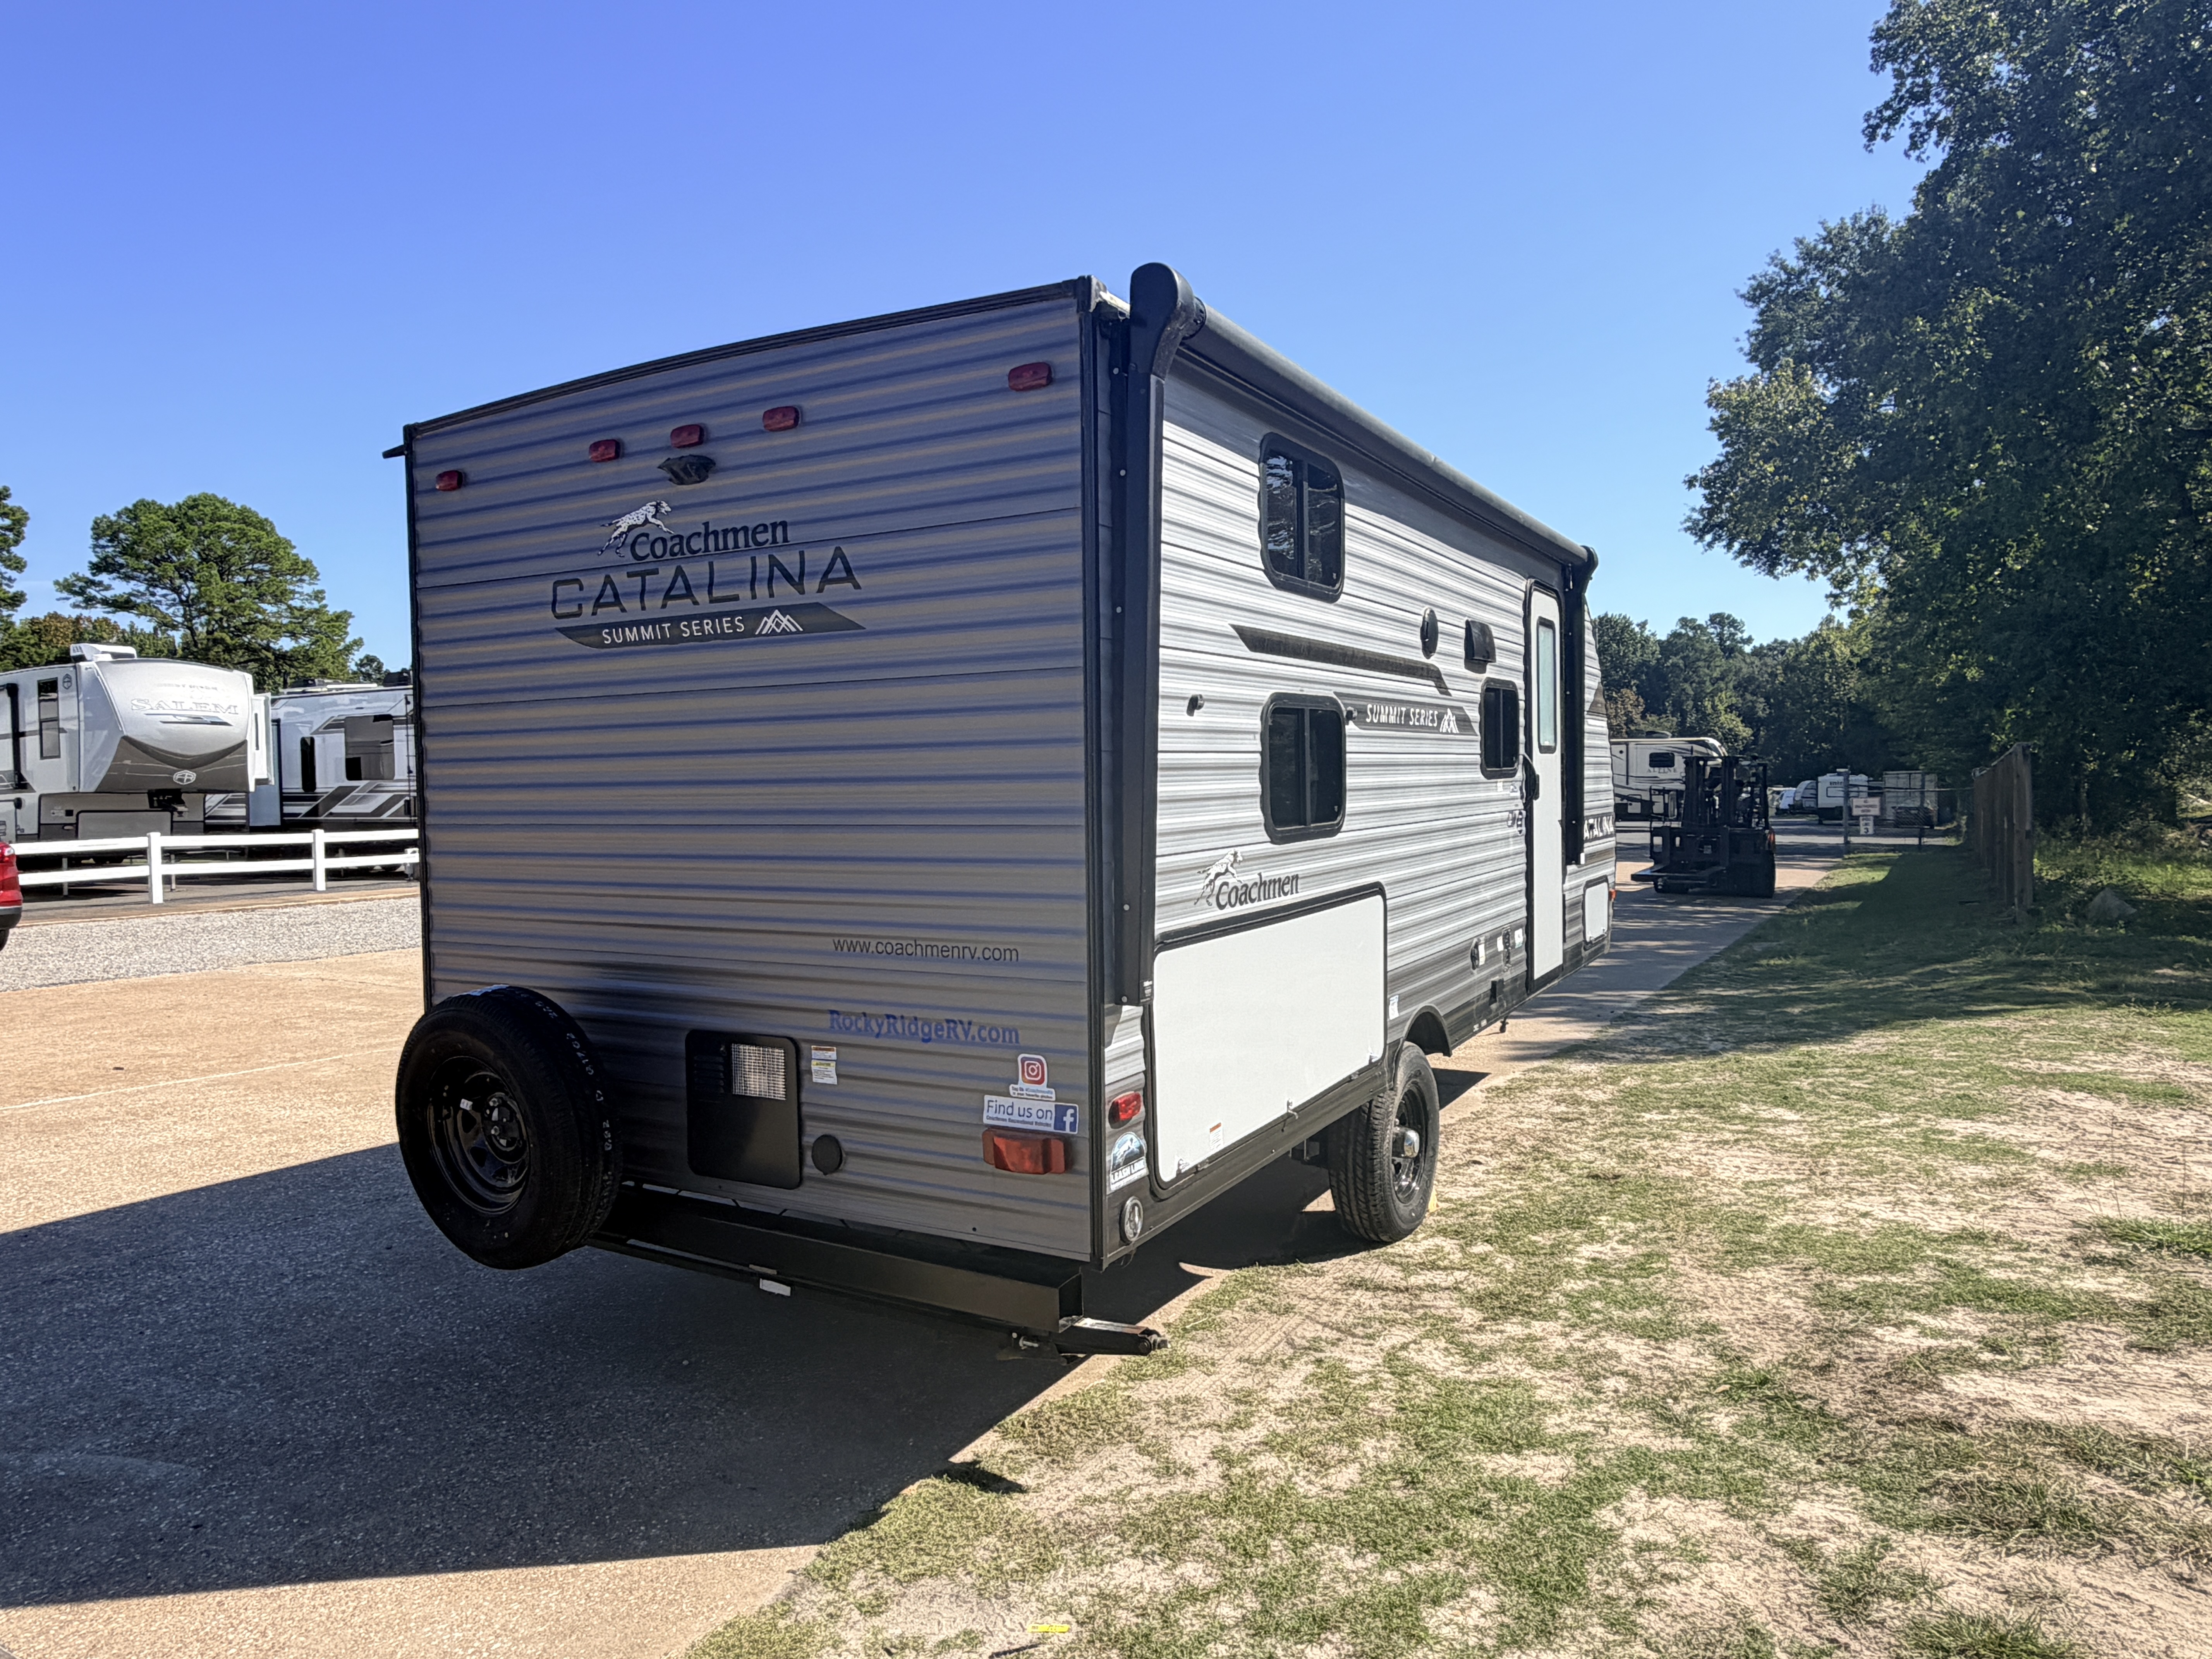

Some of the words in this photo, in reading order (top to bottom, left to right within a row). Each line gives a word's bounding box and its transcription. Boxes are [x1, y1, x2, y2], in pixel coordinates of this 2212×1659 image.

[630, 520, 790, 561] Coachmen
[551, 546, 862, 620] CATALINA
[602, 623, 671, 644] SUMMIT
[680, 616, 745, 637] SERIES
[131, 698, 239, 714] SALEM
[1365, 703, 1407, 724] SUMMIT
[1409, 708, 1438, 727] SERIES
[1216, 872, 1299, 910] Coachmen
[832, 938, 1019, 962] www.coachmenrv.com
[828, 1009, 1020, 1043] RockyRidgeRV.com
[987, 1099, 1014, 1116] Find
[1018, 1106, 1032, 1118] us
[1036, 1108, 1053, 1121] on
